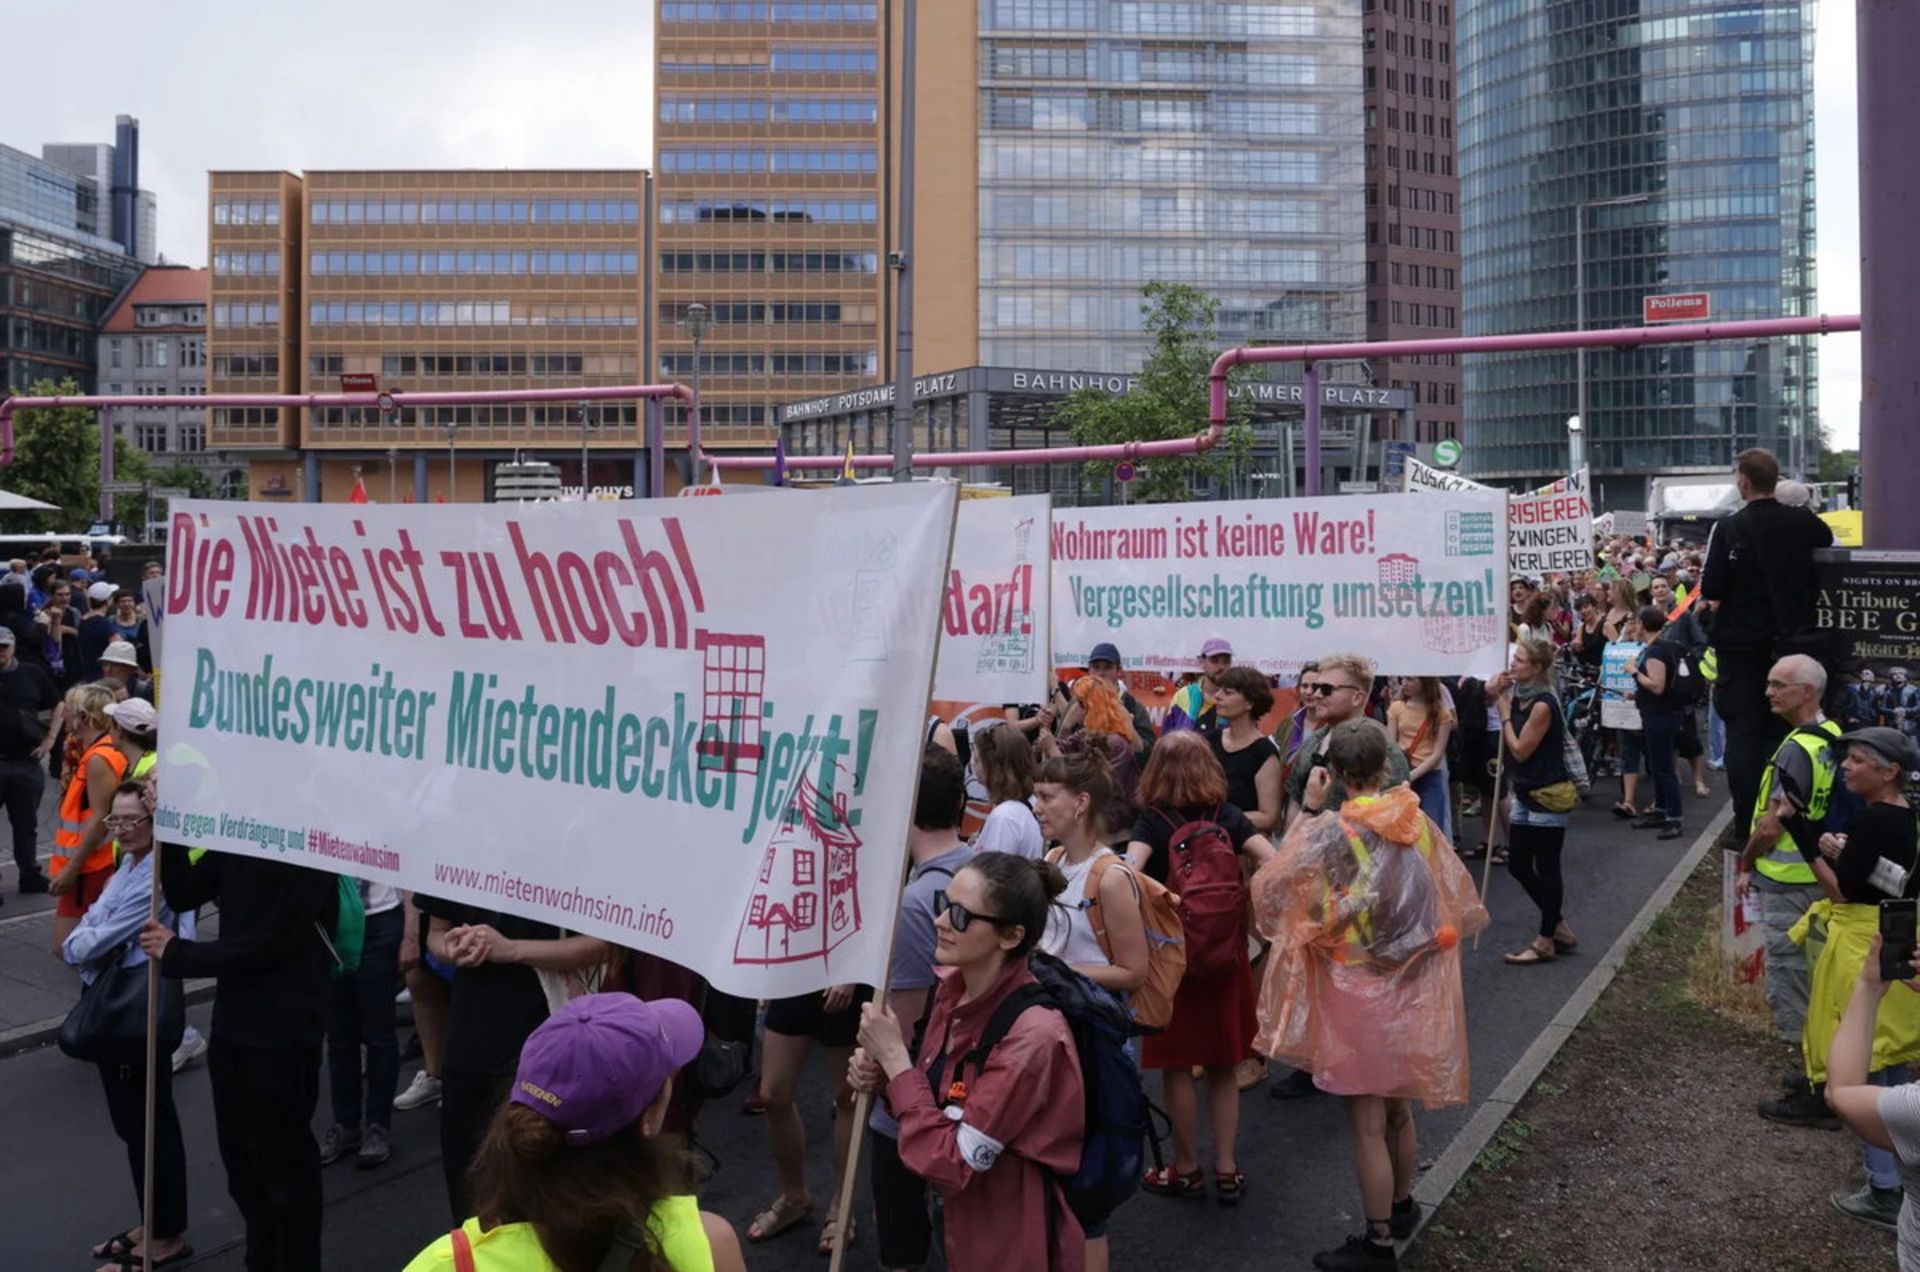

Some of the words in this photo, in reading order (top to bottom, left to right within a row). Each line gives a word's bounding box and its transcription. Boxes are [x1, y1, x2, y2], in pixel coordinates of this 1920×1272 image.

[786, 399, 831, 418] BAHNHOF
[838, 385, 897, 409] POTSDAME
[914, 374, 956, 397] PLATZ
[1013, 372, 1139, 393] BAHNHOF
[1325, 387, 1390, 404] PLATZ
[1175, 516, 1209, 558] ist
[1215, 513, 1285, 558] keine
[1292, 508, 1376, 556] Ware!
[1510, 497, 1590, 524] RISIEREN
[167, 511, 235, 619] Die
[237, 514, 369, 629] Miete
[352, 519, 446, 637] ist
[440, 550, 523, 641] zu
[505, 516, 709, 652] hoch!
[944, 564, 1033, 637] darf!
[1069, 573, 1325, 629] Vergesellschaftung
[1332, 568, 1496, 618] umsetzen!
[1816, 589, 1832, 606] A
[1836, 589, 1911, 609] Tribute
[1842, 577, 1882, 585] NIGHTS
[1885, 578, 1900, 586] ON
[1816, 608, 1881, 631] BEE
[188, 647, 437, 761] Bundesweiter
[182, 812, 216, 839] gegen
[219, 812, 286, 853] Verdrängung
[287, 826, 305, 851] und
[308, 828, 400, 872] #Mietenwahnsinn
[434, 862, 675, 940] www.mietenwahnsinn.info
